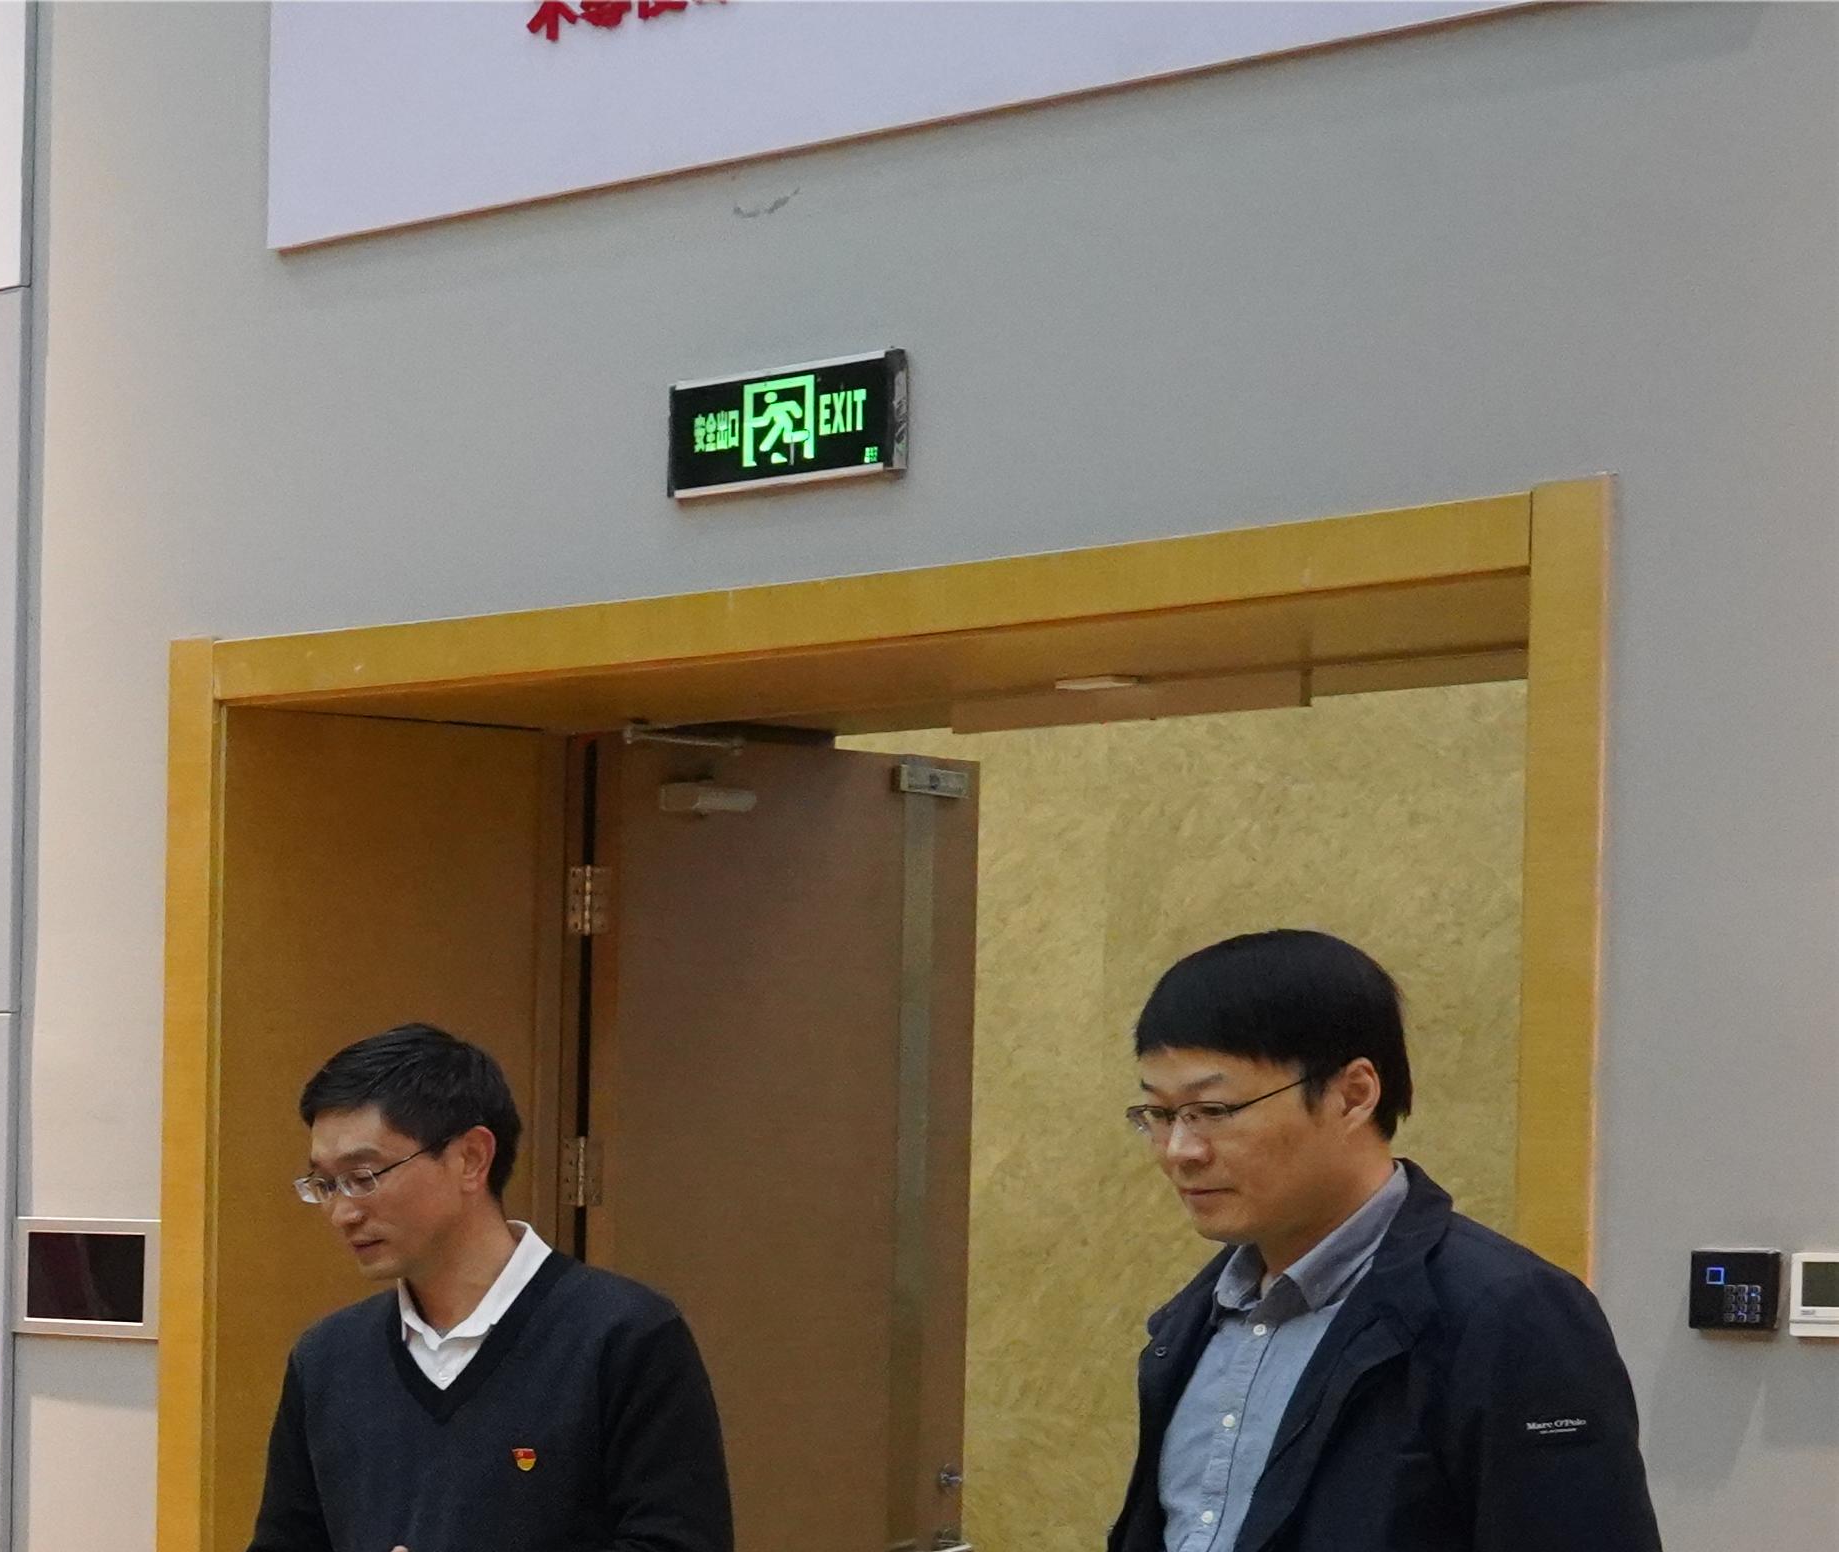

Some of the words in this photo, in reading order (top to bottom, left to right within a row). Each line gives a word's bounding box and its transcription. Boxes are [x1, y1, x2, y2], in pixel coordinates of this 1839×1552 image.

[692, 409, 740, 453] 安全出口
[818, 387, 867, 437] EXIT
